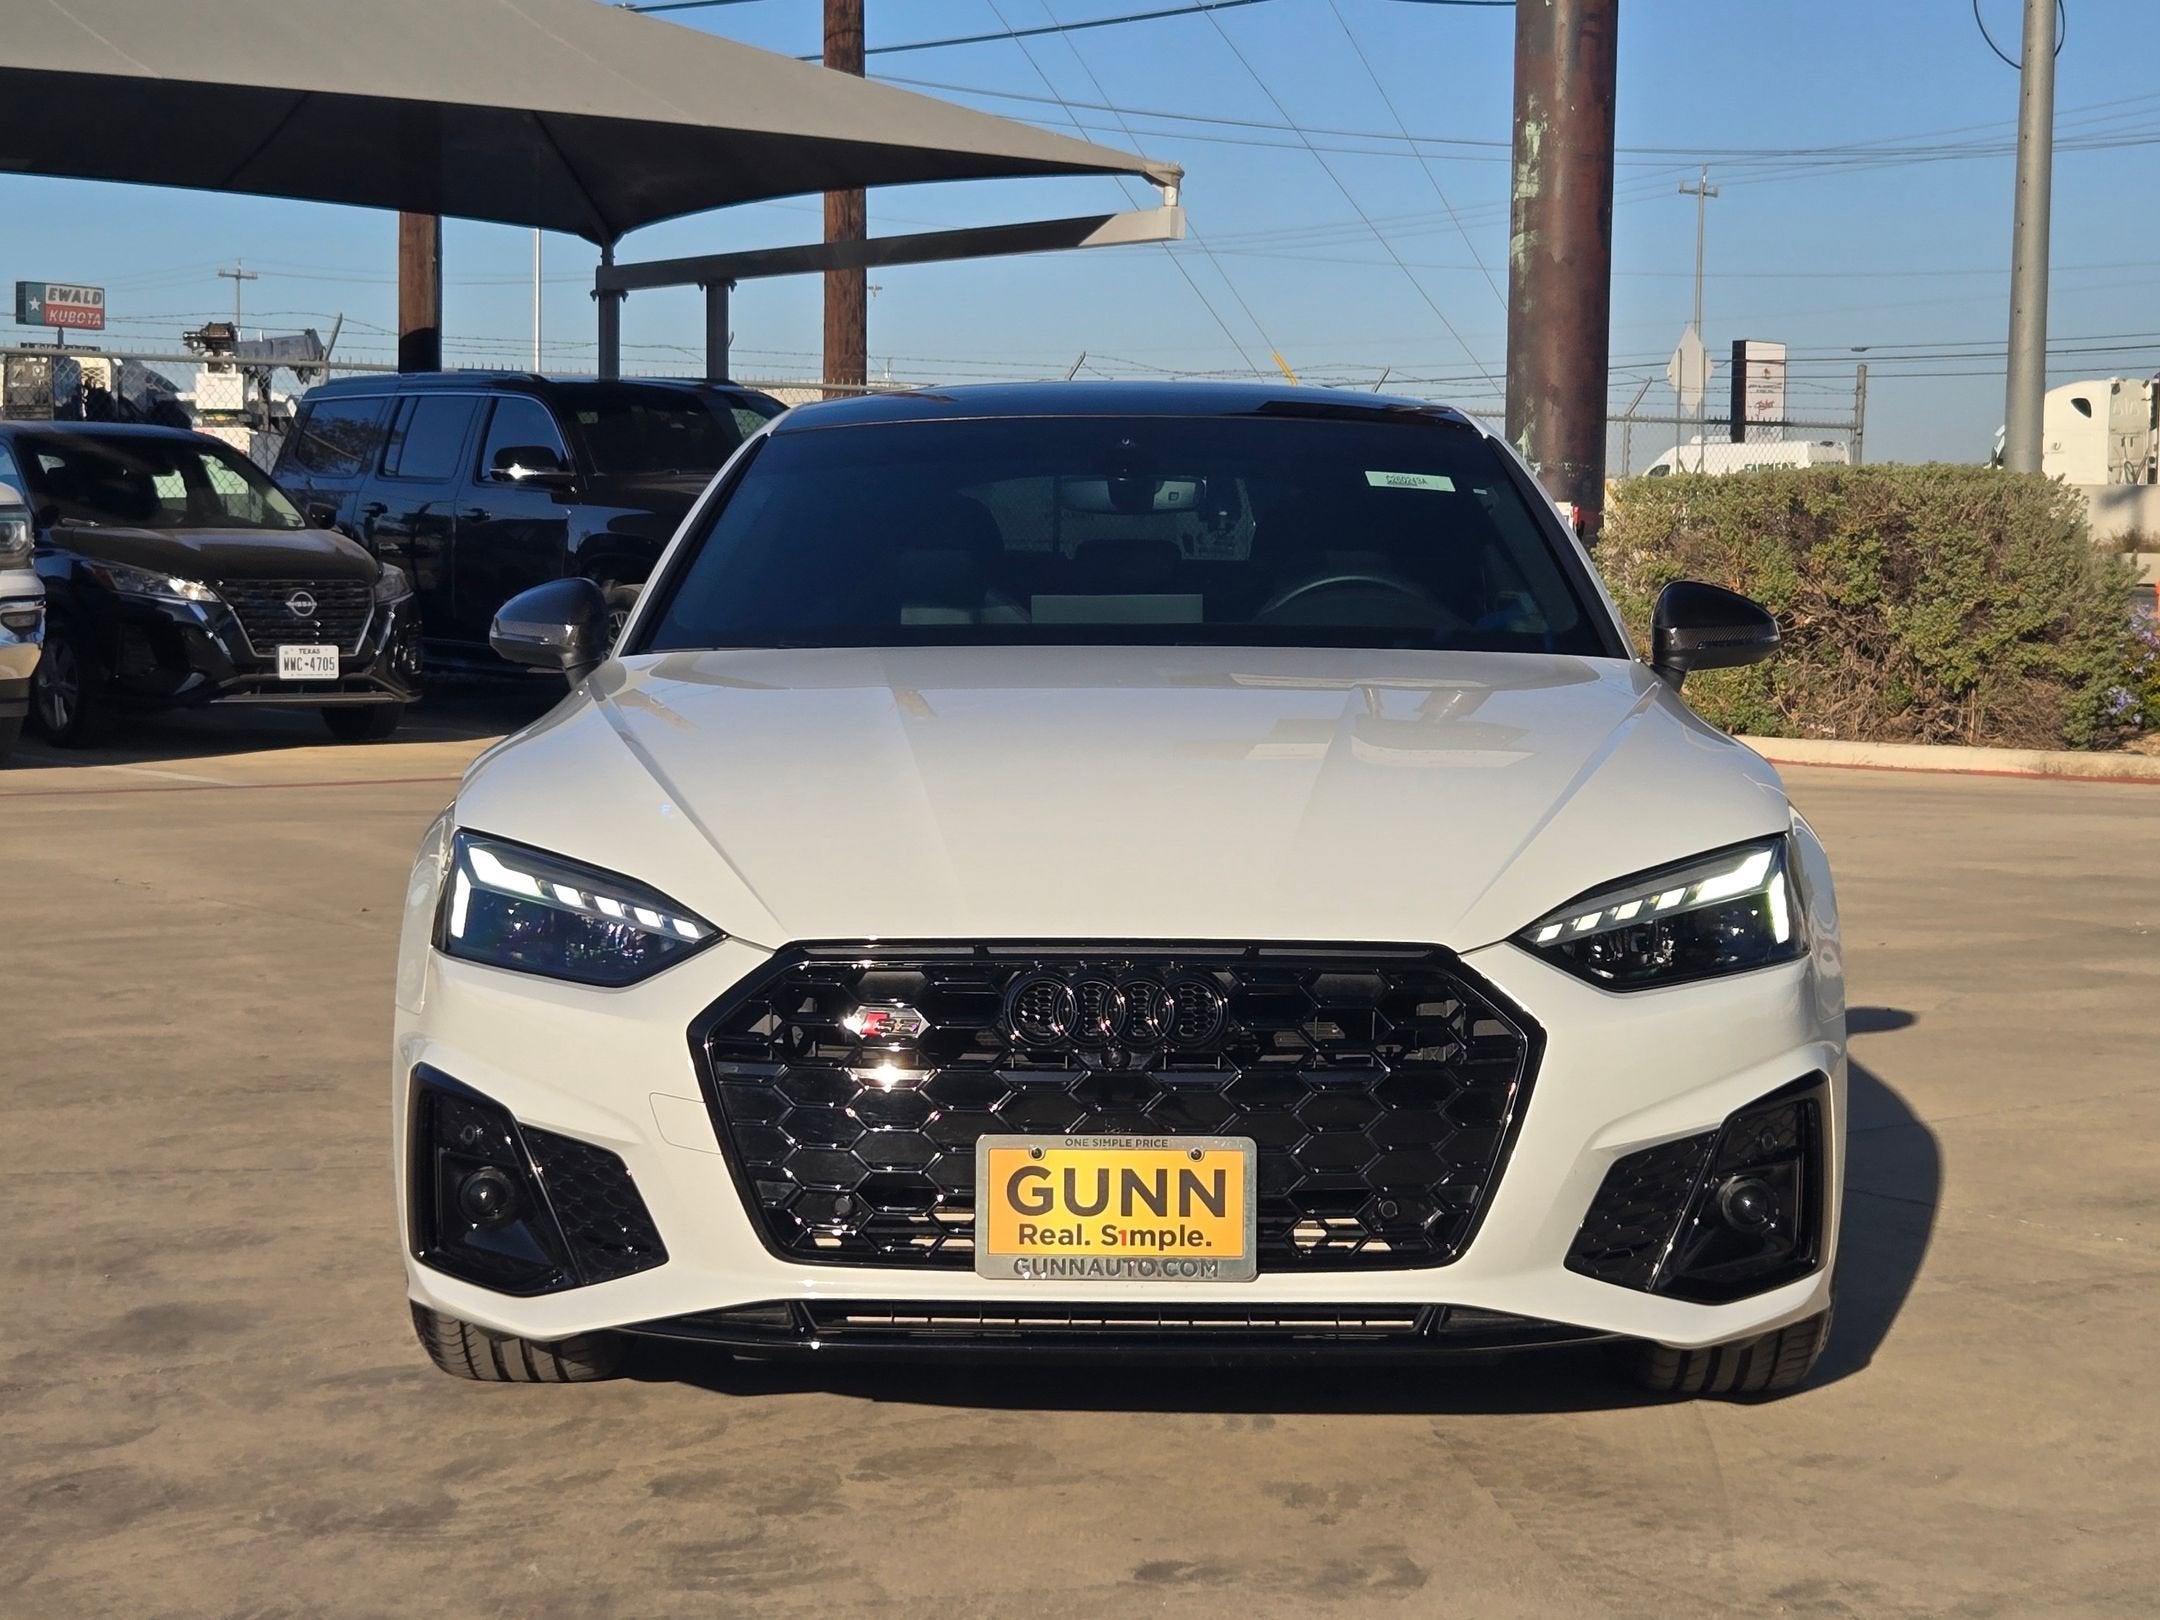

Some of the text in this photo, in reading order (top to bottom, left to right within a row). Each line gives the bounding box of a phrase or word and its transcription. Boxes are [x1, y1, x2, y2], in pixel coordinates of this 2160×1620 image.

[47, 287, 103, 305] EWALD
[48, 309, 101, 326] KUBOTA
[1065, 1138, 1168, 1148] ONE SIMPLE PRICE
[1006, 1165, 1226, 1218] GUNN
[1019, 1223, 1090, 1246] Real.
[1013, 1257, 1219, 1278] GUNNAUTO.COM
